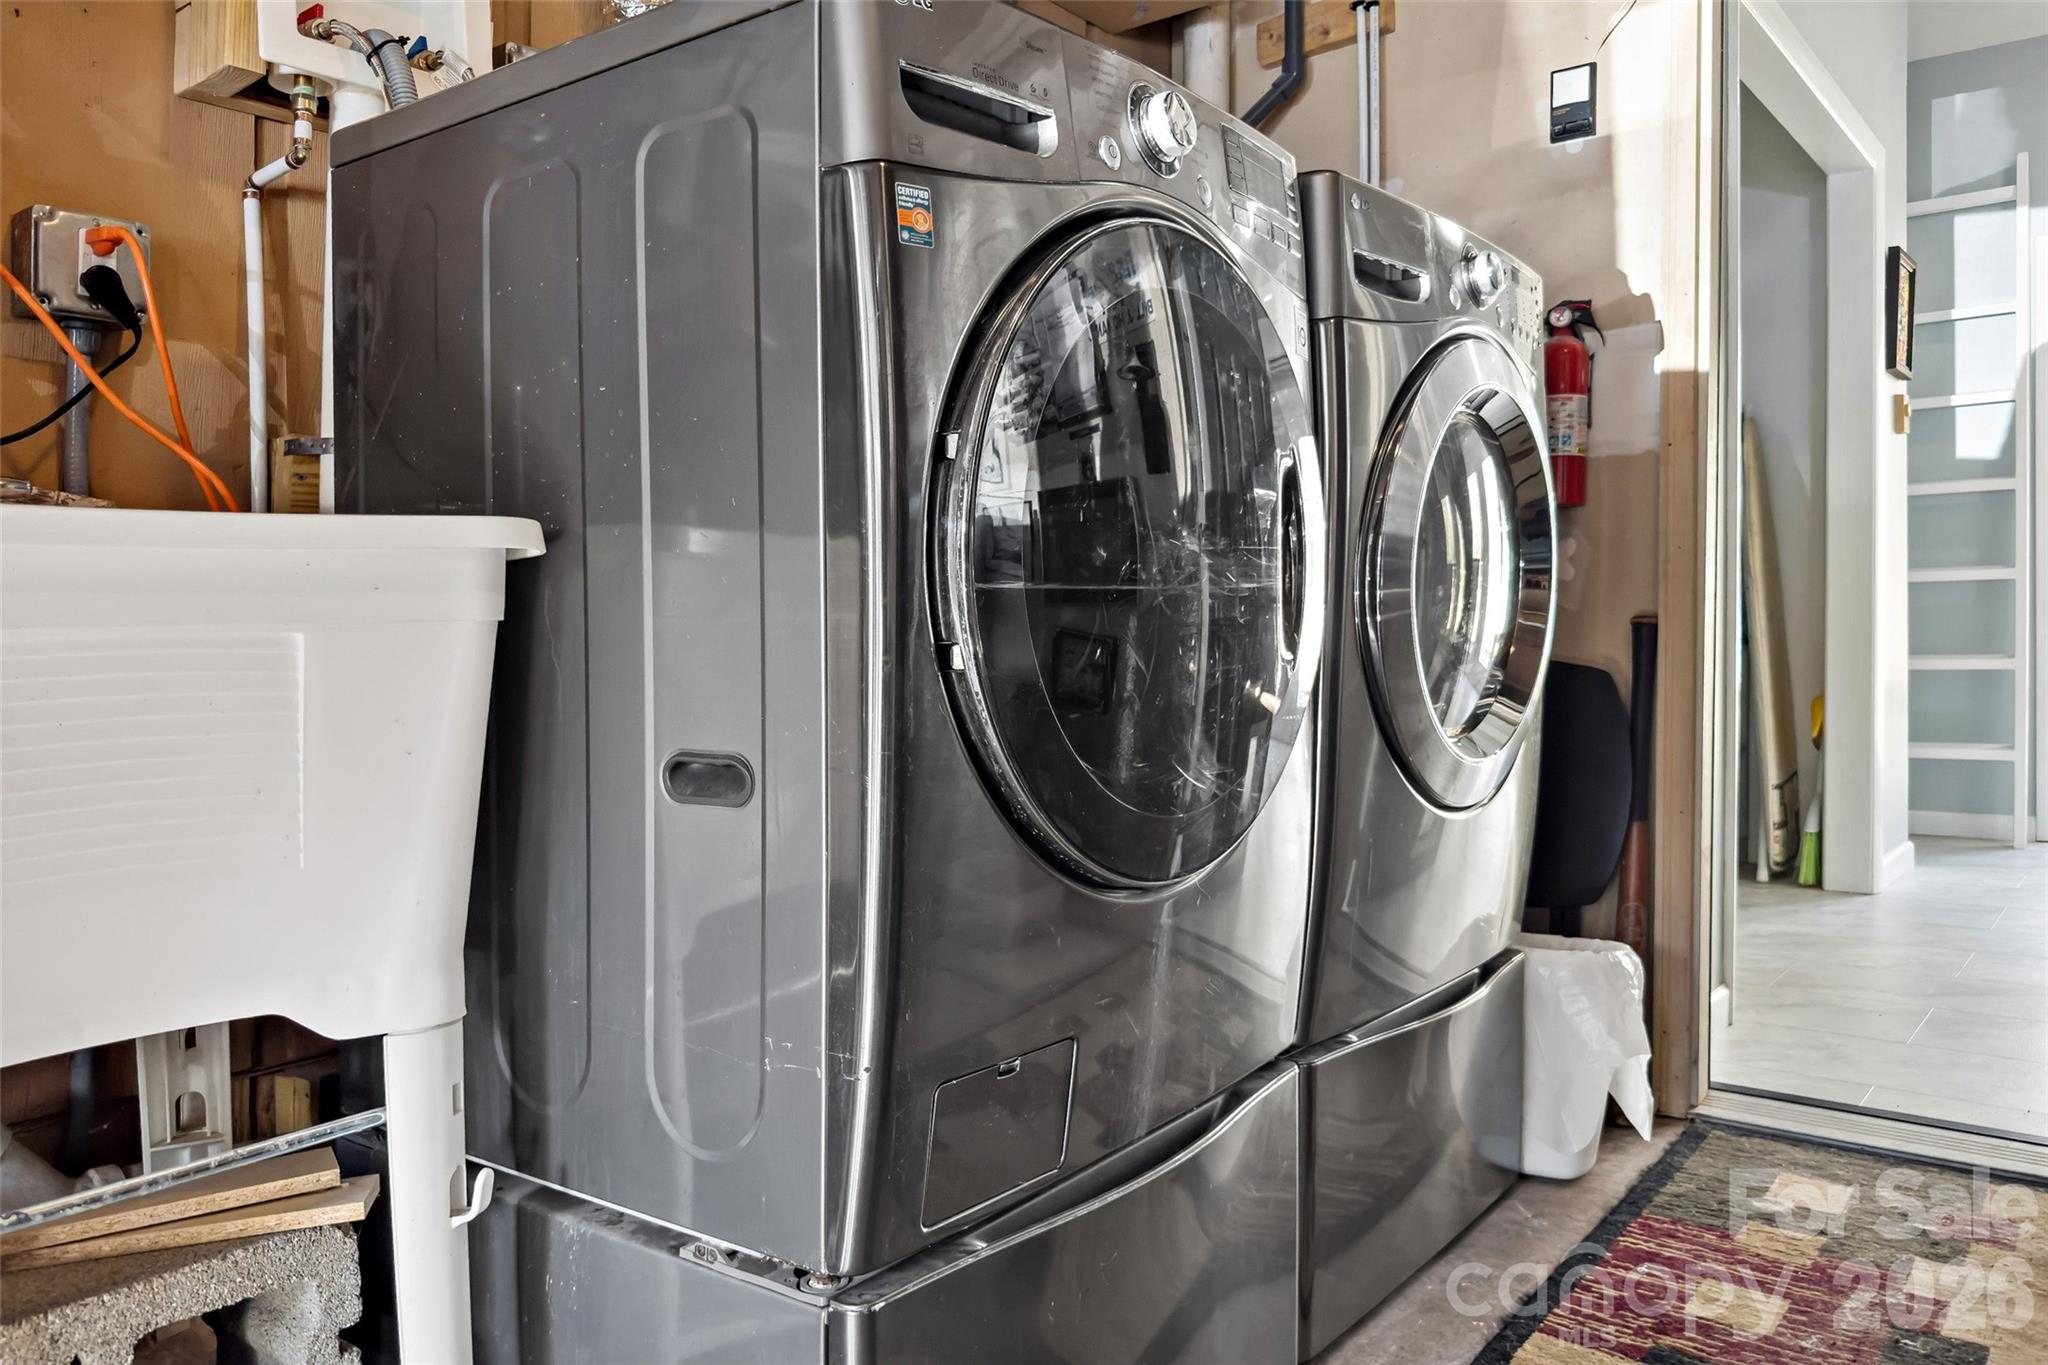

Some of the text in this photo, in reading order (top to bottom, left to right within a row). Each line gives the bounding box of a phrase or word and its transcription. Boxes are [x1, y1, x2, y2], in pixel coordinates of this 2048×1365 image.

[972, 67, 997, 85] Direct
[998, 75, 1019, 92] Drive
[897, 186, 929, 199] CERTIFIED
